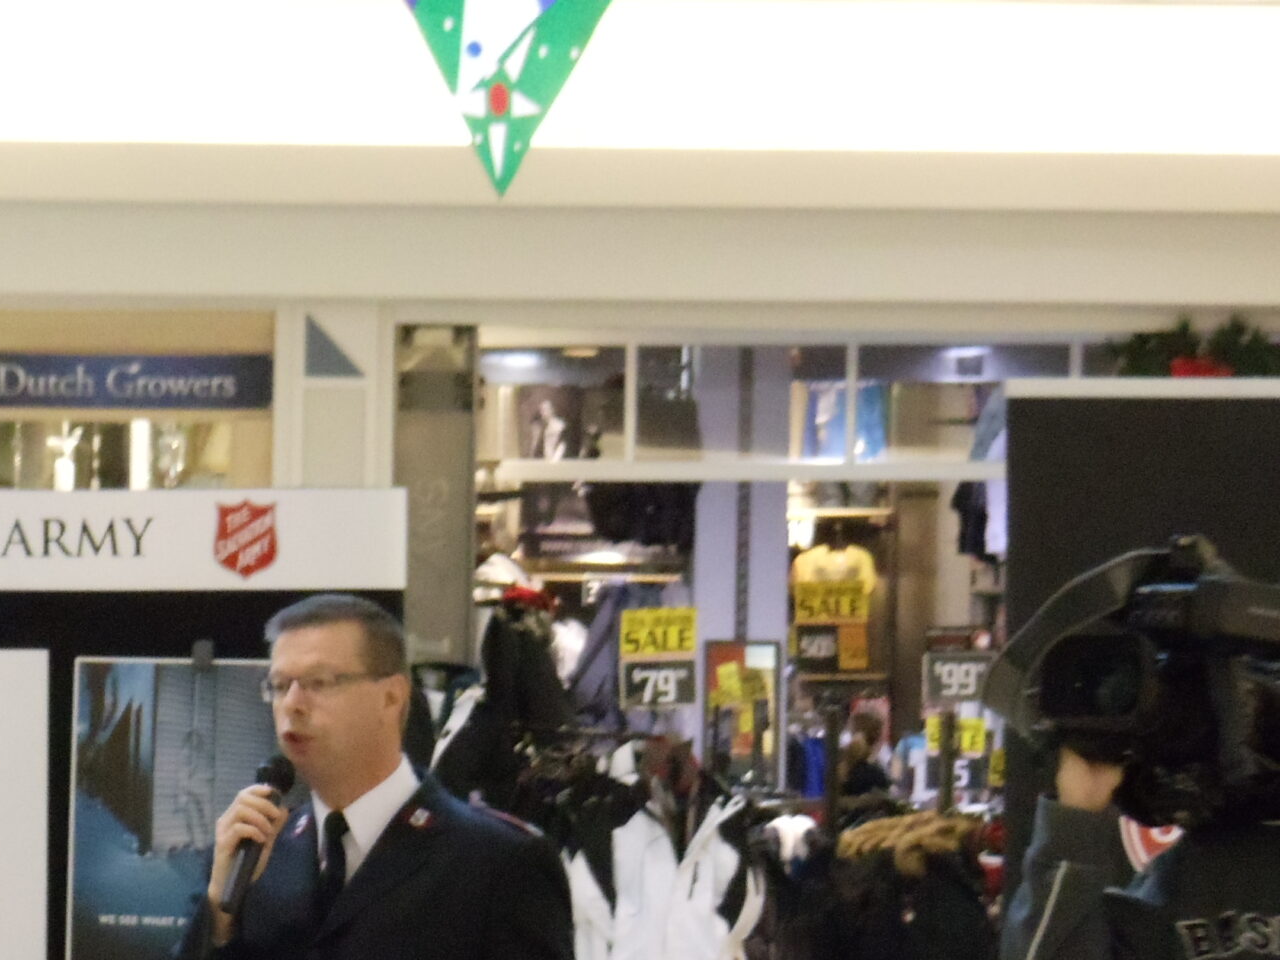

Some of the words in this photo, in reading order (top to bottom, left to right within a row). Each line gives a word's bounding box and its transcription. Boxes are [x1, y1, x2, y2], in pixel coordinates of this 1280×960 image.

[106, 361, 237, 399] Growers
[0, 517, 154, 558] ARMY
[624, 627, 692, 653] SALE
